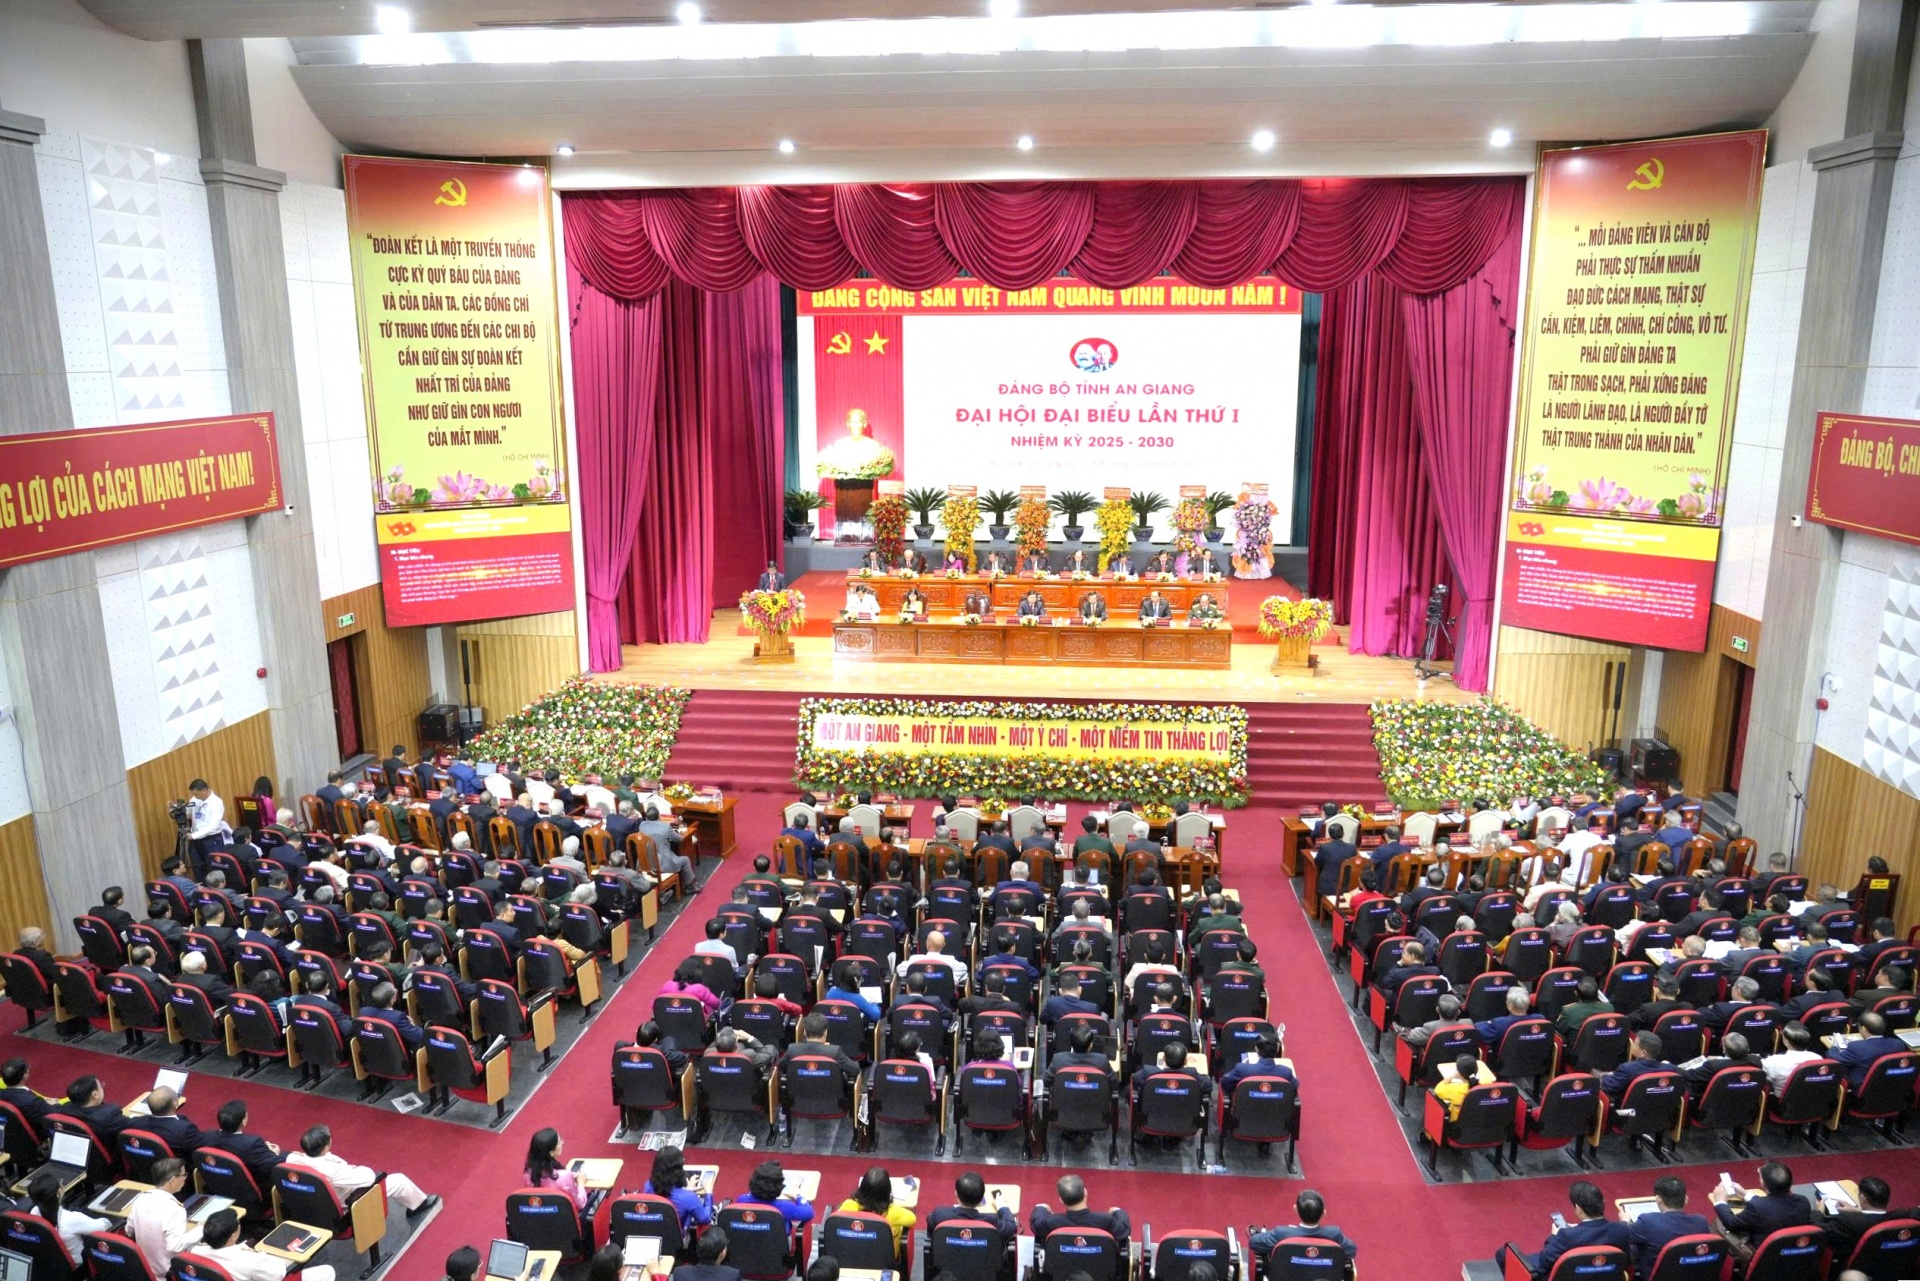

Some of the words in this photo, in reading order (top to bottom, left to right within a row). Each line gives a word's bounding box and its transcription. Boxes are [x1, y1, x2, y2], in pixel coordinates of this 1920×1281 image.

[1608, 221, 1633, 246] ĐẢNG
[1636, 222, 1657, 244] VIÊN
[1660, 221, 1670, 243] VÀ
[1674, 220, 1694, 242] CÁN
[1696, 218, 1710, 246] BỘ
[405, 234, 422, 255] KẾT
[426, 236, 438, 255] LÀ
[441, 237, 462, 260] MỘT
[504, 238, 536, 258] THỐNG
[388, 265, 408, 286] CỰC
[412, 264, 424, 283] KỲ
[428, 265, 446, 284] QUÝ
[450, 266, 469, 284] BÁU
[472, 264, 492, 284] CỦA
[494, 265, 520, 285] ĐẢNG
[1576, 252, 1597, 276] PHẢI
[1599, 256, 1622, 279] THỰC
[1624, 255, 1638, 278] SỰ
[1640, 249, 1665, 274] THẤM
[382, 292, 396, 310] VÀ
[399, 290, 420, 310] CỦA
[422, 292, 443, 310] DÂN
[446, 296, 460, 311] TA.
[462, 294, 482, 311] CÁC
[514, 294, 530, 312] CHÍ
[866, 284, 915, 311] CỘNG
[962, 284, 1002, 310] VIỆT
[1006, 288, 1047, 306] NAM
[1053, 286, 1114, 308] QUANG
[1120, 286, 1164, 306] VINH
[1232, 283, 1274, 306] NĂM
[1279, 286, 1286, 306] !
[1566, 288, 1584, 309] ĐẠO
[1586, 284, 1604, 306] ĐỨC
[1607, 284, 1631, 305] CÁCH
[1633, 286, 1663, 308] MẠNG,
[1666, 282, 1690, 308] THẬT
[1691, 283, 1706, 308] SỰ
[380, 320, 392, 338] TỪ
[395, 322, 428, 338] TRUNG
[431, 322, 458, 338] ƯƠNG
[461, 319, 480, 338] ĐẾN
[483, 321, 502, 338] CÁC
[505, 324, 520, 338] CHI
[524, 321, 536, 342] BỘ
[1563, 314, 1587, 338] KIỆM,
[1590, 314, 1613, 336] LIÊM,
[1616, 314, 1646, 336] CHÍNH,
[1648, 313, 1666, 334] CHÍ
[1667, 313, 1695, 336] CÔNG,
[1698, 312, 1710, 334] VÔ
[1714, 315, 1728, 334] TƯ.
[422, 348, 440, 366] GIỮ
[442, 347, 458, 366] GÌN
[462, 349, 474, 368] SỰ
[477, 347, 504, 365] ĐOÀN
[506, 346, 522, 365] KẾT
[1580, 340, 1600, 363] PHẢI
[1603, 343, 1620, 363] GIỮ
[1620, 343, 1636, 363] GÌN
[1638, 340, 1663, 364] ĐẢNG
[1666, 346, 1676, 364] TA
[416, 372, 442, 393] NHẤT
[444, 375, 460, 392] TRÍ
[463, 372, 482, 392] CỦA
[484, 372, 510, 392] ĐẢNG
[998, 380, 1044, 396] ĐẢNG
[1050, 381, 1070, 398] BỘ
[1076, 380, 1110, 396] TỈNH
[1116, 384, 1138, 395] AN
[1142, 384, 1195, 396] GIANG
[1548, 371, 1568, 394] THẬT
[1570, 374, 1598, 392] TRONG
[1600, 374, 1626, 396] SẠCH,
[1629, 370, 1651, 393] PHẢI
[1652, 372, 1678, 394] XỨNG
[1680, 372, 1708, 394] ĐÁNG
[408, 404, 429, 420] NHƯ
[432, 402, 448, 420] GIỮ
[451, 401, 468, 419] GÌN
[470, 404, 490, 418] CON
[956, 408, 991, 426] ĐẠI
[999, 405, 1036, 426] HỘI
[1044, 408, 1080, 426] ĐẠI
[1087, 400, 1130, 423] BIỂU
[1138, 402, 1178, 423] LẦN
[1185, 406, 1226, 423] THỨ
[1232, 409, 1240, 423] I
[1542, 398, 1552, 418] LÀ
[1555, 398, 1582, 420] NGƯỜI
[1583, 400, 1606, 420] LÃNH
[1608, 404, 1628, 425] ĐẠO,
[1630, 402, 1641, 422] LÀ
[1644, 403, 1672, 424] NGƯỜI
[1696, 402, 1708, 425] TỚ
[428, 426, 448, 446] CỦA
[450, 425, 472, 446] MẮT
[1011, 433, 1058, 450] NHIỆM
[1064, 434, 1082, 447] KỲ
[1088, 436, 1124, 448] 2025
[1138, 436, 1174, 448] 2030
[1542, 427, 1562, 450] THẬT
[1564, 430, 1592, 448] TRUNG
[1594, 429, 1622, 450] THÀNH
[1625, 428, 1643, 451] CỦA
[1645, 431, 1672, 453] NHÂN
[1840, 429, 1874, 468] ĐẢNG
[1874, 436, 1895, 478] BỘ,
[18, 474, 52, 532] LỢI
[52, 461, 92, 519] CỦA
[92, 461, 138, 512] CÁCH
[140, 460, 186, 510] MẠNG
[186, 449, 216, 502] VIỆT
[218, 451, 254, 490] NAM!
[845, 722, 861, 741] AN
[865, 723, 900, 742] GIANG
[912, 721, 936, 748] MỘT
[940, 719, 964, 744] TẦM
[968, 722, 996, 746] NHÌN
[1009, 723, 1034, 750] MỘT
[1038, 724, 1045, 746] Ý
[1048, 724, 1068, 747] CHÍ
[1080, 724, 1106, 752] MỘT
[1109, 723, 1140, 750] NIỀM
[1144, 730, 1163, 750] TIN
[1167, 723, 1206, 750] THẮNG
[1210, 730, 1228, 755] LỢI
